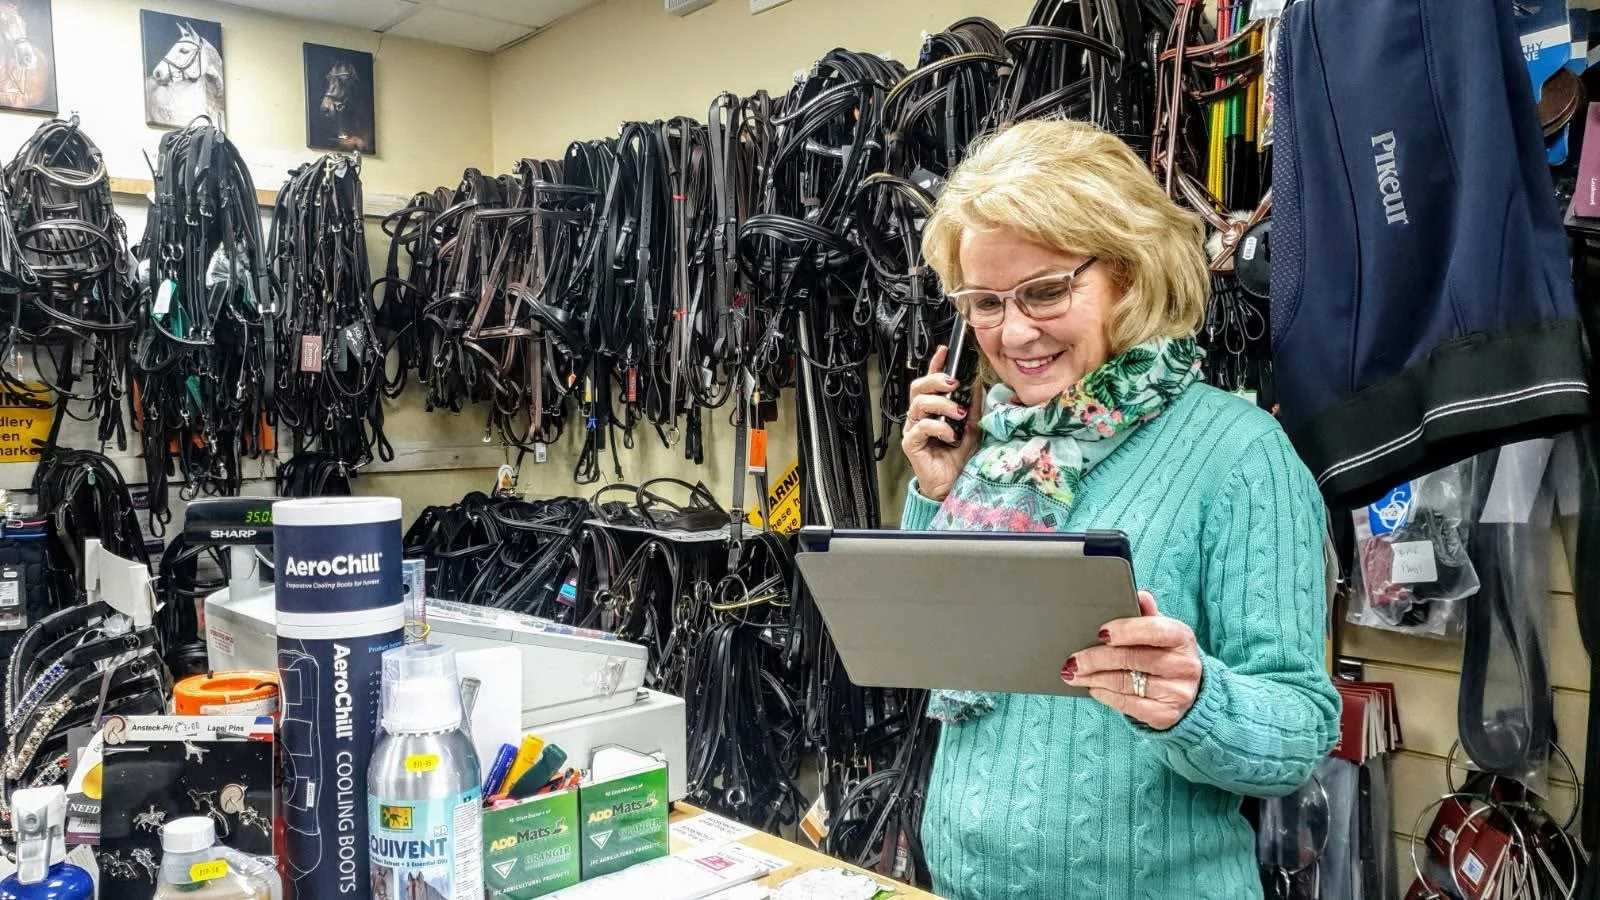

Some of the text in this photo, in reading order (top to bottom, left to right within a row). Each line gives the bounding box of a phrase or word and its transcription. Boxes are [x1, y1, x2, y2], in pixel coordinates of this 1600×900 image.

[210, 530, 257, 539] SHARP
[285, 552, 382, 576] AeroChill
[333, 643, 353, 740] AeroChill
[337, 752, 356, 893] COOLING BOOTS
